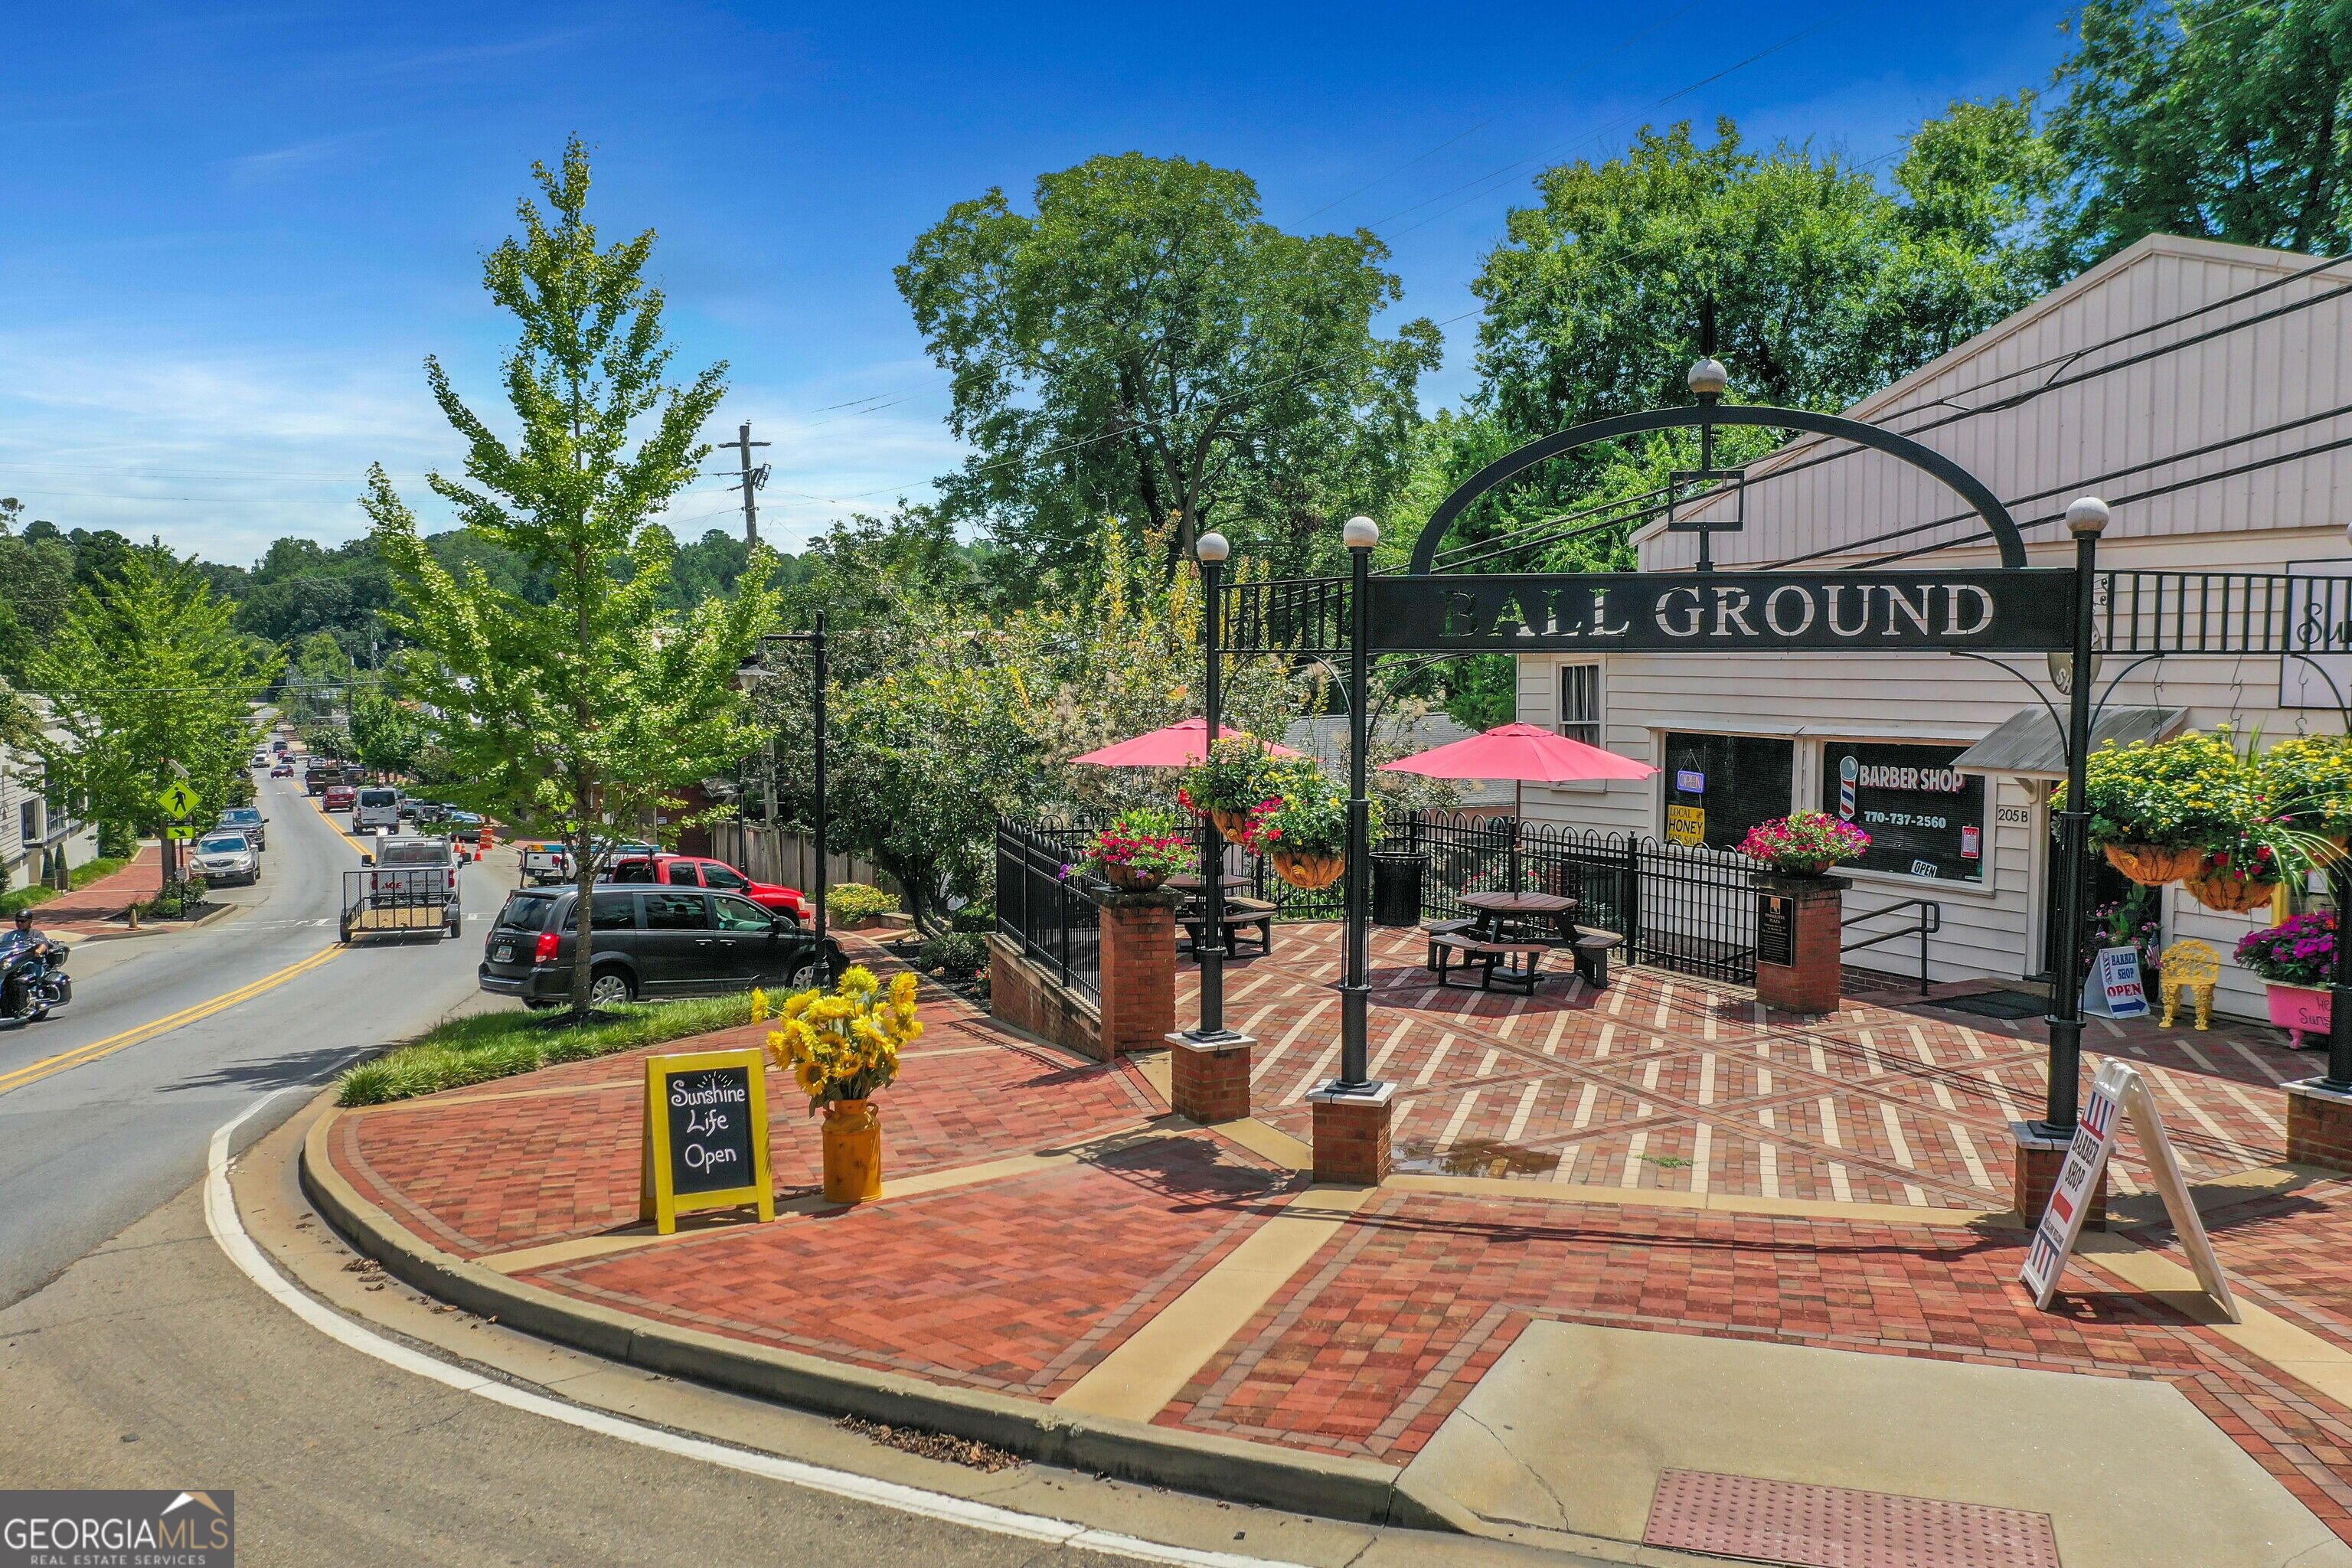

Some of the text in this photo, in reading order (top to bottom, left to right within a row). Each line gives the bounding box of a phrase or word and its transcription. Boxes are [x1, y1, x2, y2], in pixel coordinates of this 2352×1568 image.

[1439, 585, 1994, 638] BALL GROUND
[1678, 773, 1704, 789] OPEN
[1859, 765, 1965, 792] BARBER SHOP
[1670, 807, 1692, 818] LOCAL
[1864, 811, 1947, 829] 770-737-2560
[1998, 808, 2028, 823] 205 B
[1668, 818, 1704, 835] HONEY
[1913, 861, 1936, 878] OPEN
[2111, 952, 2137, 965] BARBER
[2117, 967, 2135, 979] SHOP
[2107, 983, 2141, 997] OPEN
[671, 1078, 746, 1107] Sunshine
[686, 1109, 729, 1137] Life
[2072, 1129, 2100, 1168] BARBER
[684, 1143, 737, 1174] Open
[2065, 1160, 2086, 1192] SHOP
